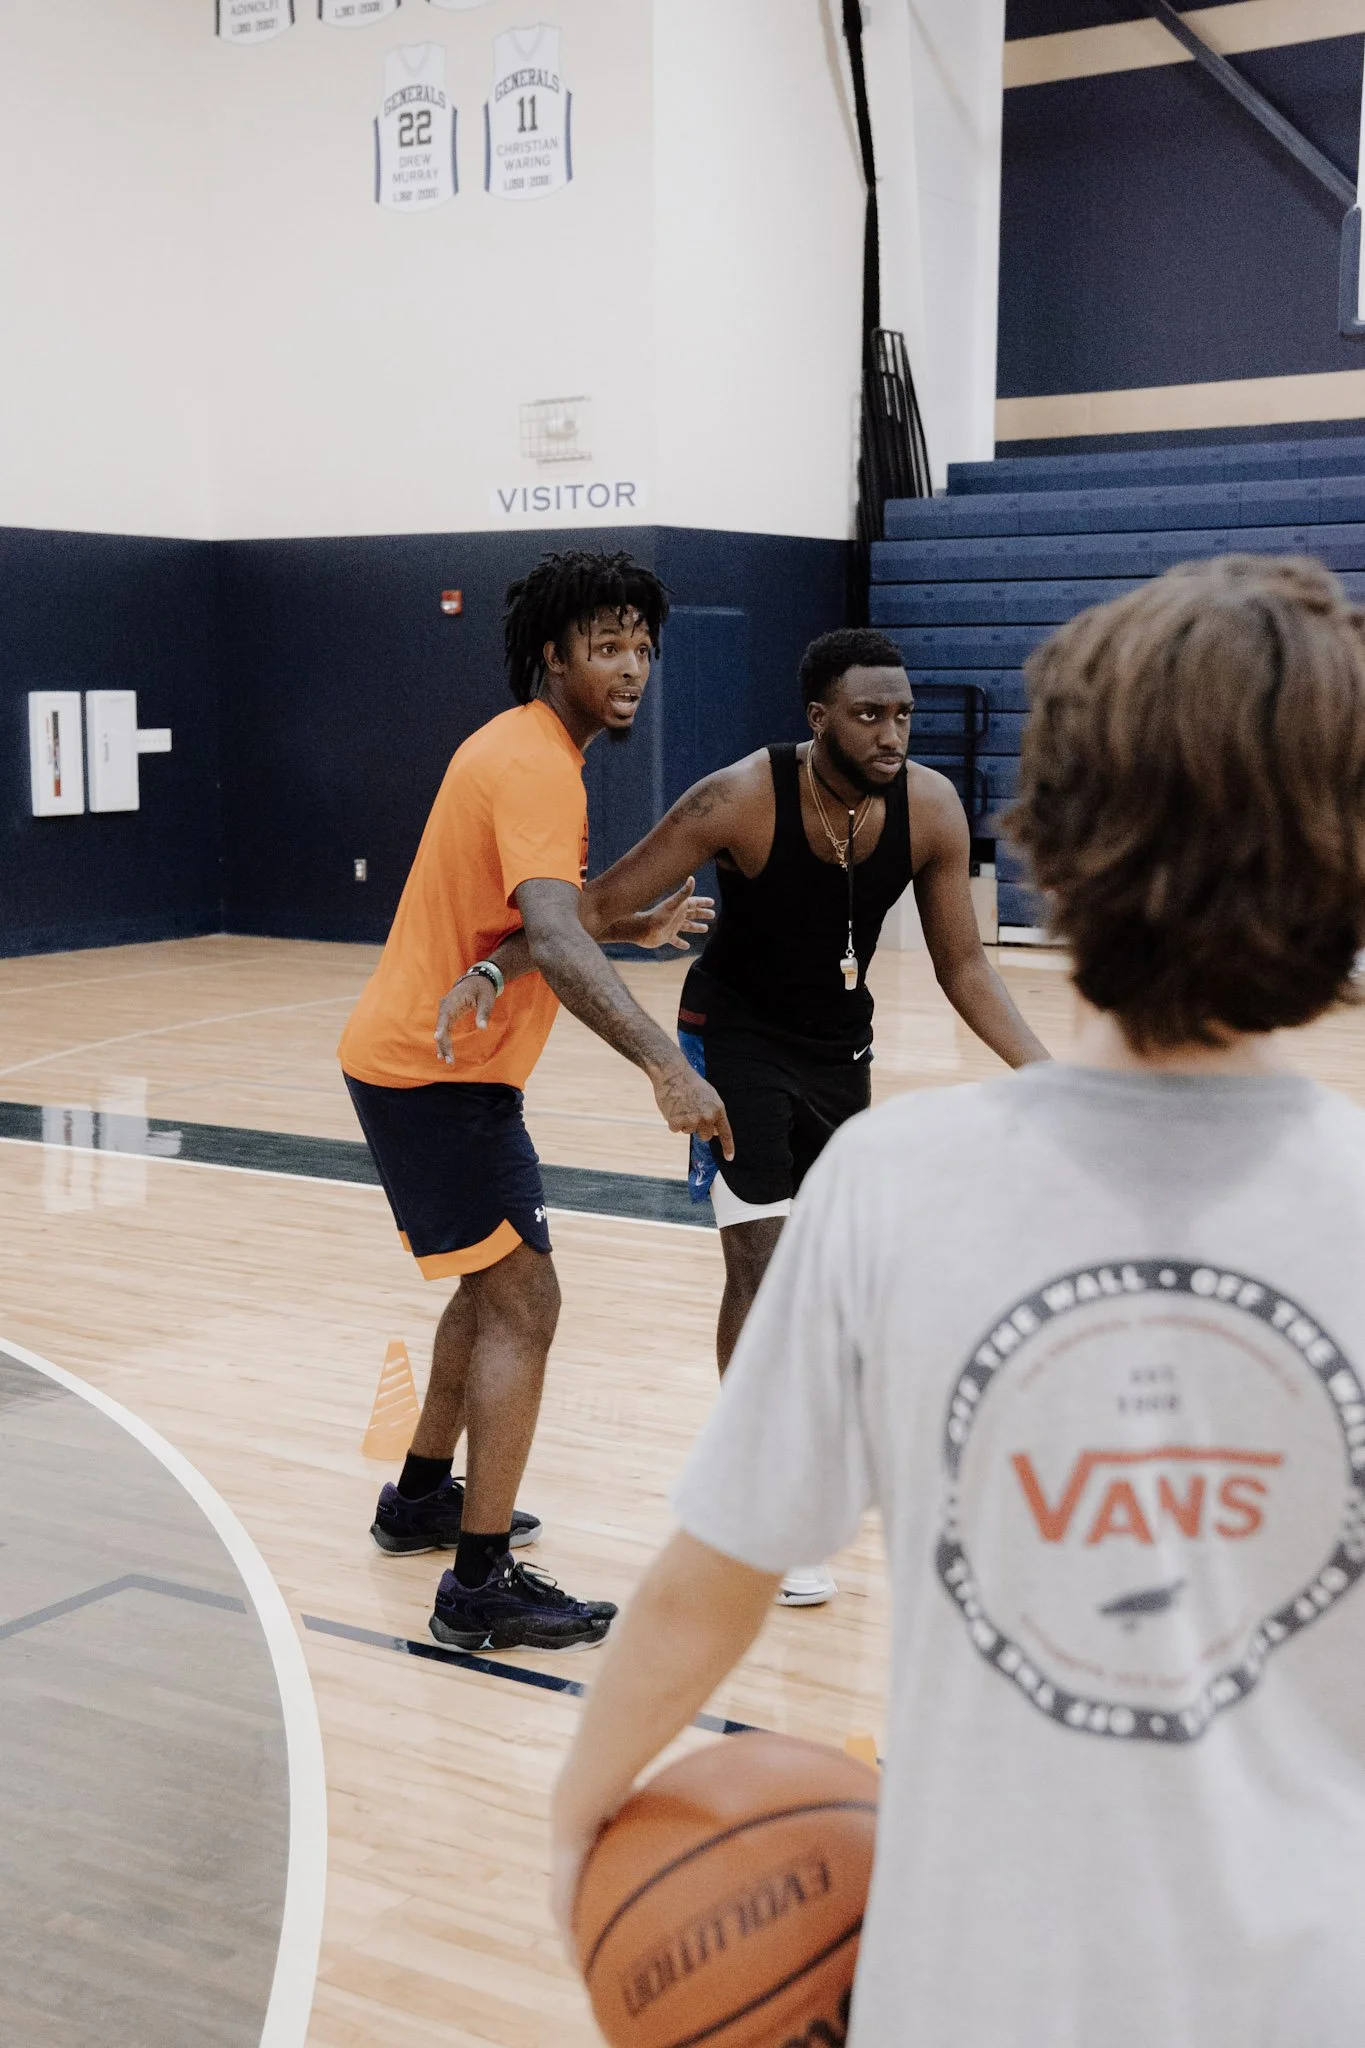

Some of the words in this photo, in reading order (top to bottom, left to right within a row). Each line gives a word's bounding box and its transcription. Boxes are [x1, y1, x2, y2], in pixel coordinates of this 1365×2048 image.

[384, 84, 446, 116] GENERALS
[495, 68, 560, 103] GENERALS
[398, 110, 432, 148] 22
[517, 95, 538, 133] 11
[399, 153, 431, 169] DREW
[496, 138, 558, 157] CHRISTIAN
[504, 154, 551, 172] WARING
[392, 168, 439, 184] MURRAY
[498, 482, 636, 513] VISITOR
[1010, 1447, 1286, 1546] VANS
